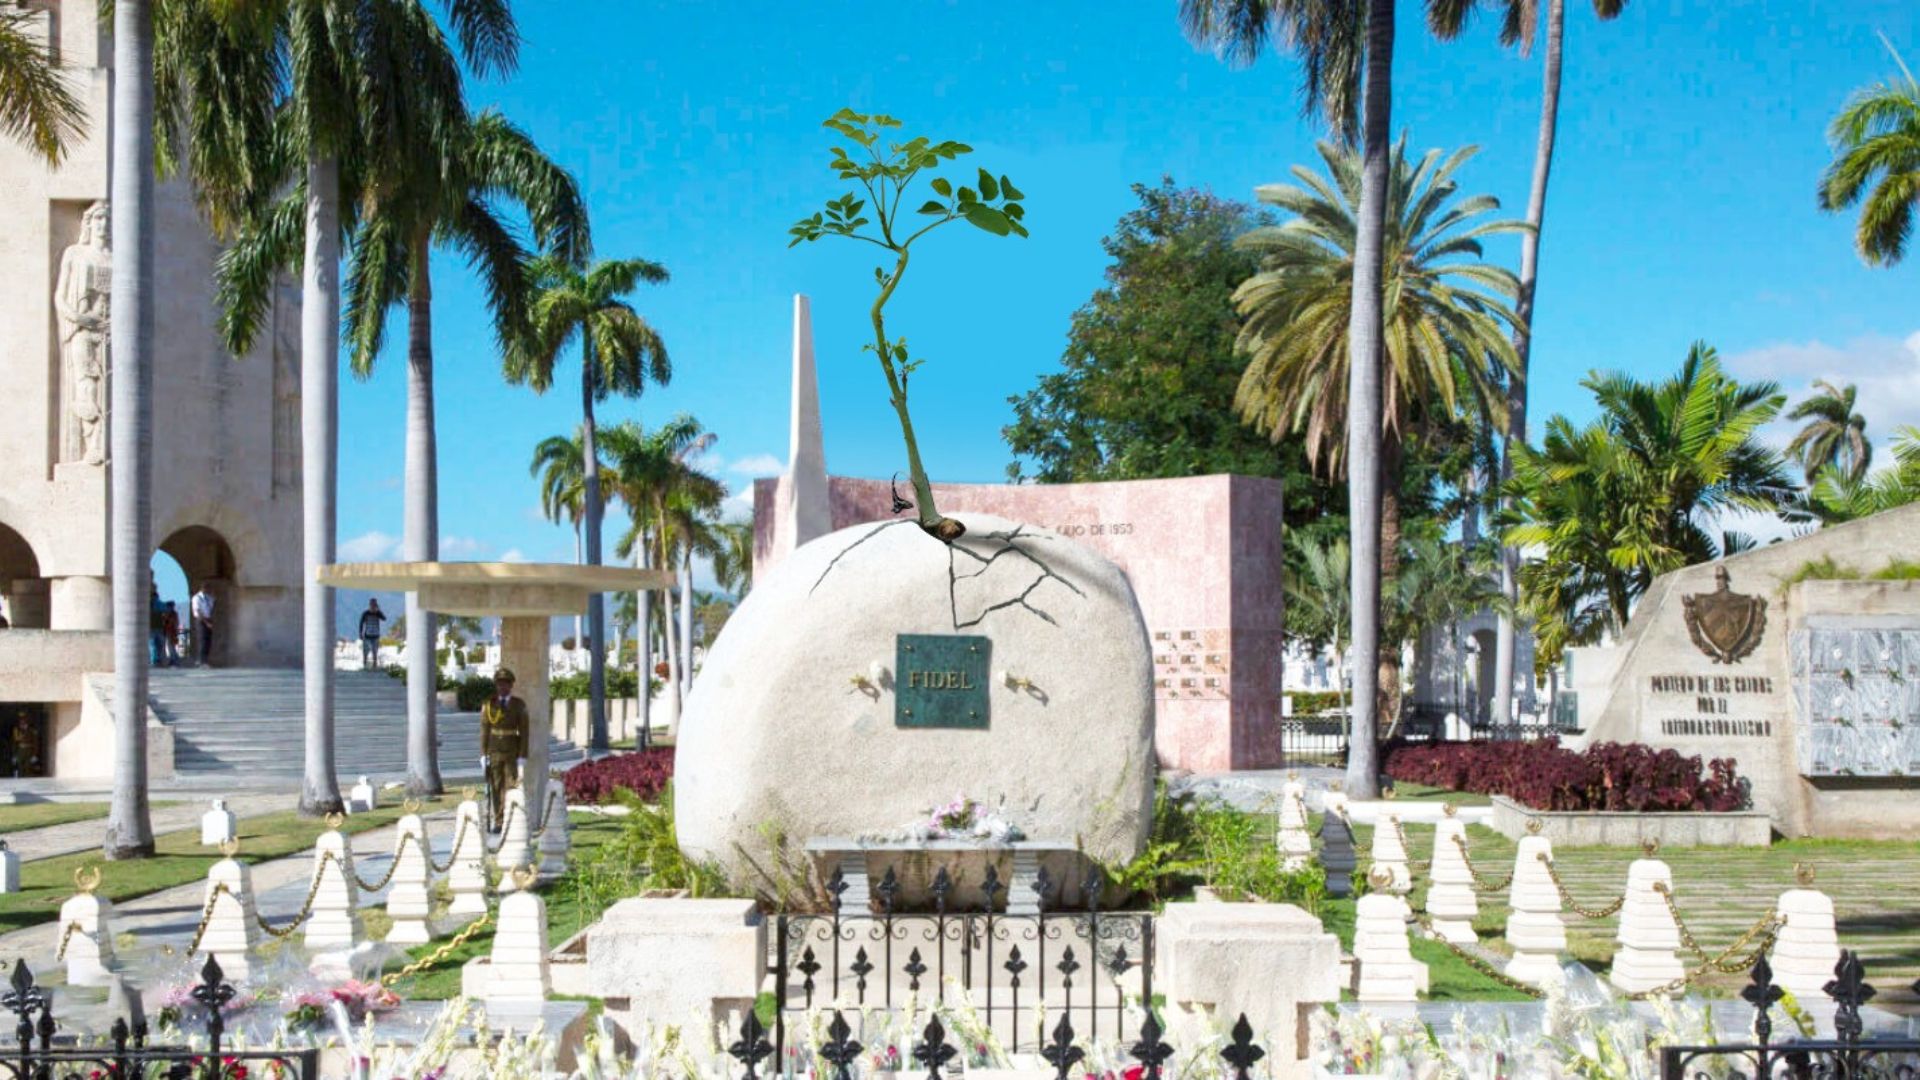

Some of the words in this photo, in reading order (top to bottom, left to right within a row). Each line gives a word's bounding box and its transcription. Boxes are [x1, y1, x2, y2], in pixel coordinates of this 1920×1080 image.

[1090, 524, 1105, 536] DE
[1110, 523, 1134, 535] 1953
[909, 671, 975, 689] FIDEL
